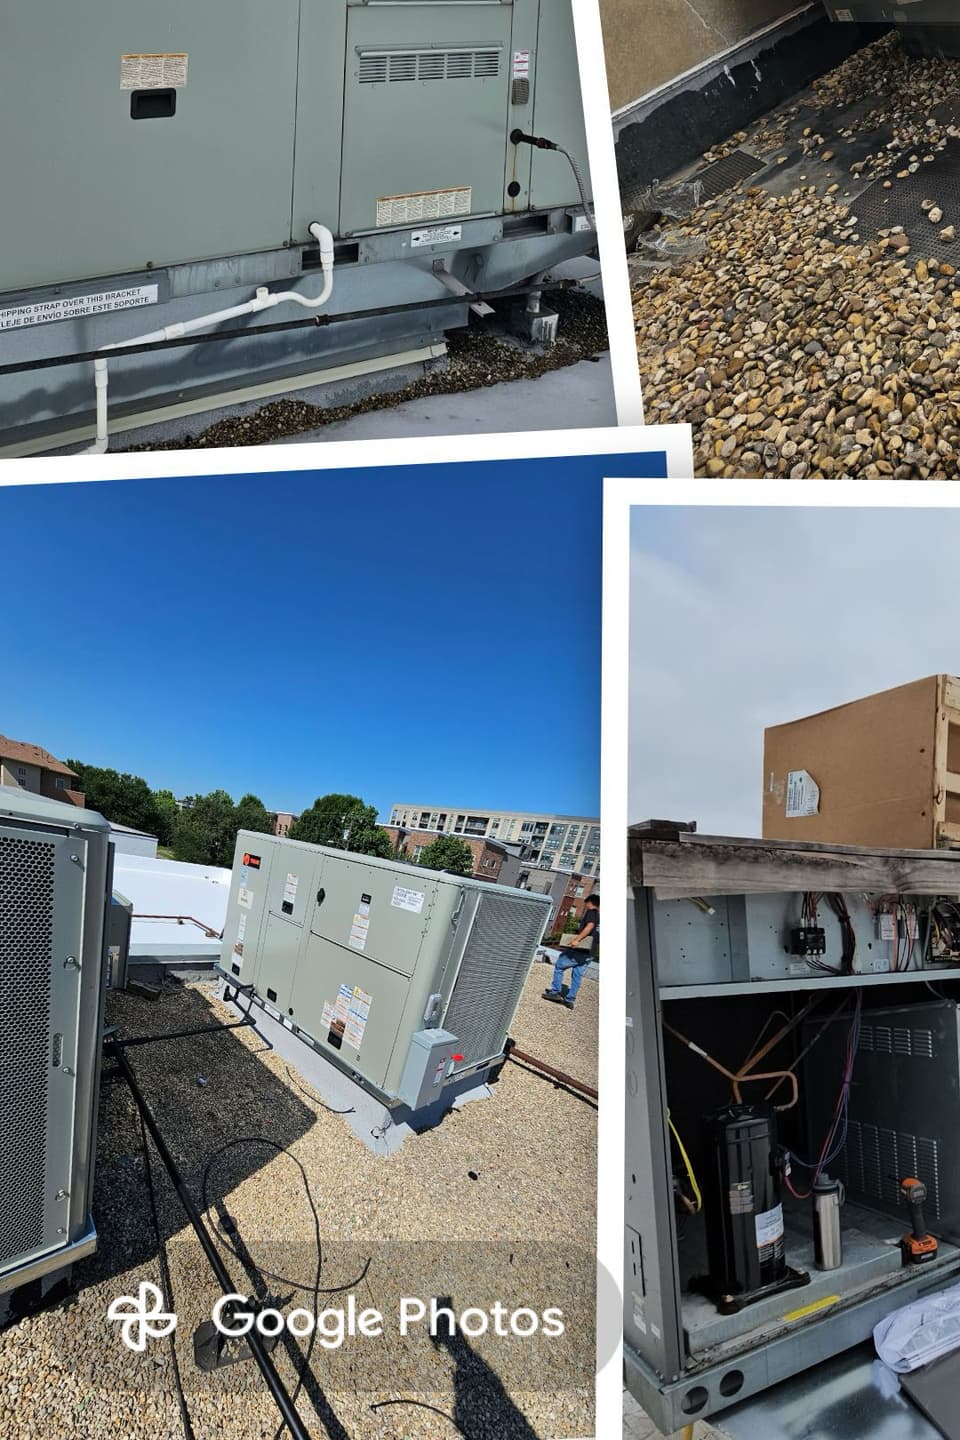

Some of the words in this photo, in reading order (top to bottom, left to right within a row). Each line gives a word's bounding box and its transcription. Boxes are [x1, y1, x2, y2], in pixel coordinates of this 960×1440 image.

[23, 316, 35, 324] DE
[63, 307, 91, 317] SOBRE
[92, 302, 112, 312] ESTE
[114, 296, 150, 309] SOPORTE
[33, 303, 60, 313] STRAP
[62, 299, 85, 308] OVER
[86, 296, 104, 305] THIS
[105, 288, 141, 301] BRACKET
